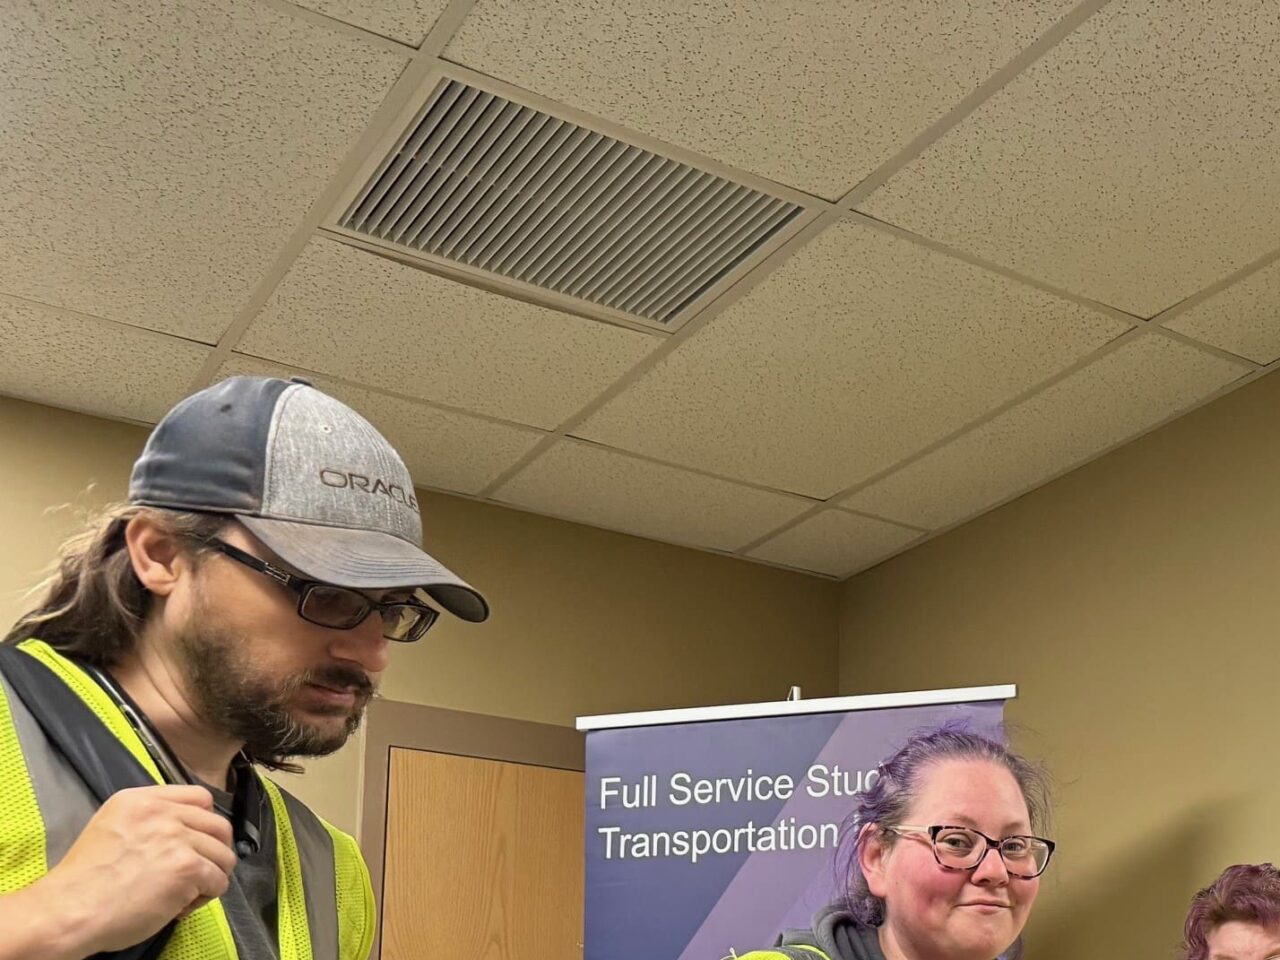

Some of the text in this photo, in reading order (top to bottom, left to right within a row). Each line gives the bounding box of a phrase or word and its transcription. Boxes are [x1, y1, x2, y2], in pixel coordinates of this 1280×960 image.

[320, 468, 420, 514] ORACLE
[600, 775, 657, 810] Full
[669, 769, 794, 806] Service
[598, 816, 839, 863] Transportation
